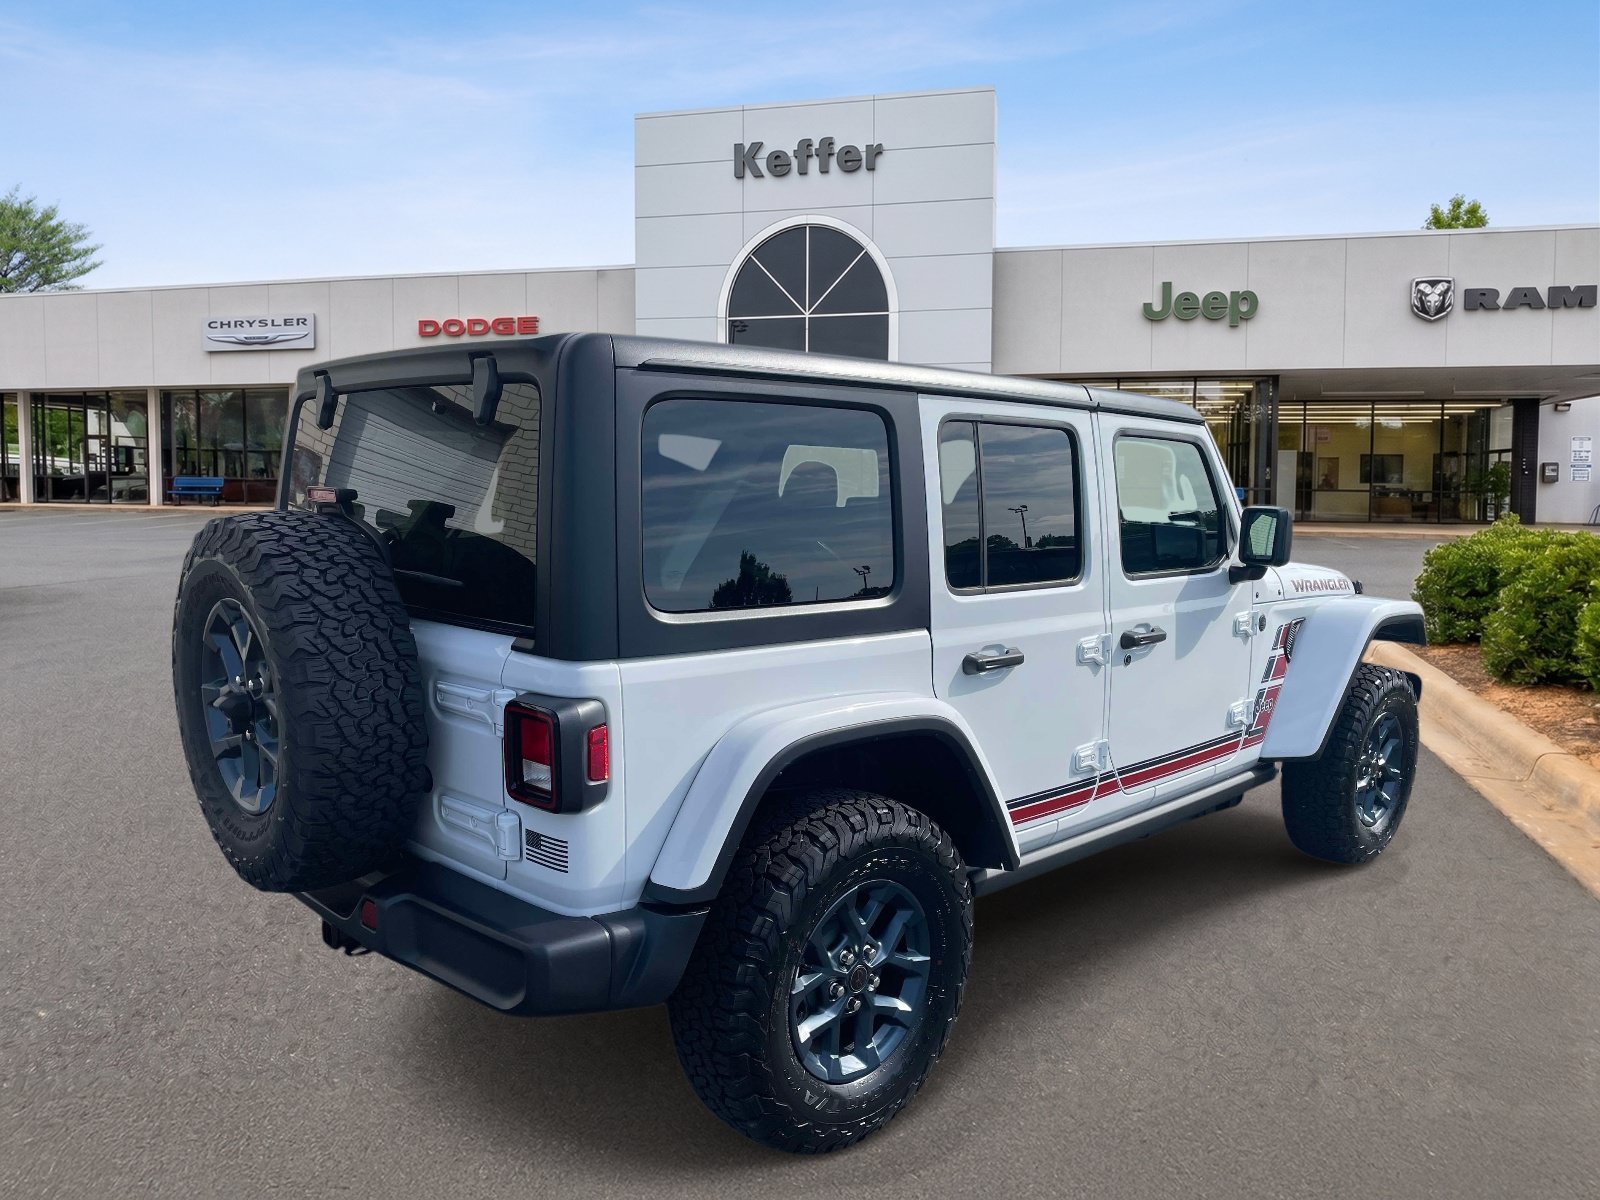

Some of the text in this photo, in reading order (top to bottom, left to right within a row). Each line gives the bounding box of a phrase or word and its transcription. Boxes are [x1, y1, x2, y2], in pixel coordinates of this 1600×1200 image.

[734, 136, 884, 179] Keffer
[1142, 281, 1259, 328] Jeep
[1463, 284, 1598, 311] RAM
[207, 317, 308, 330] CHRYSLER
[418, 316, 539, 337] DODGE
[1291, 579, 1351, 593] WRANGLER
[1255, 698, 1273, 714] Jeep
